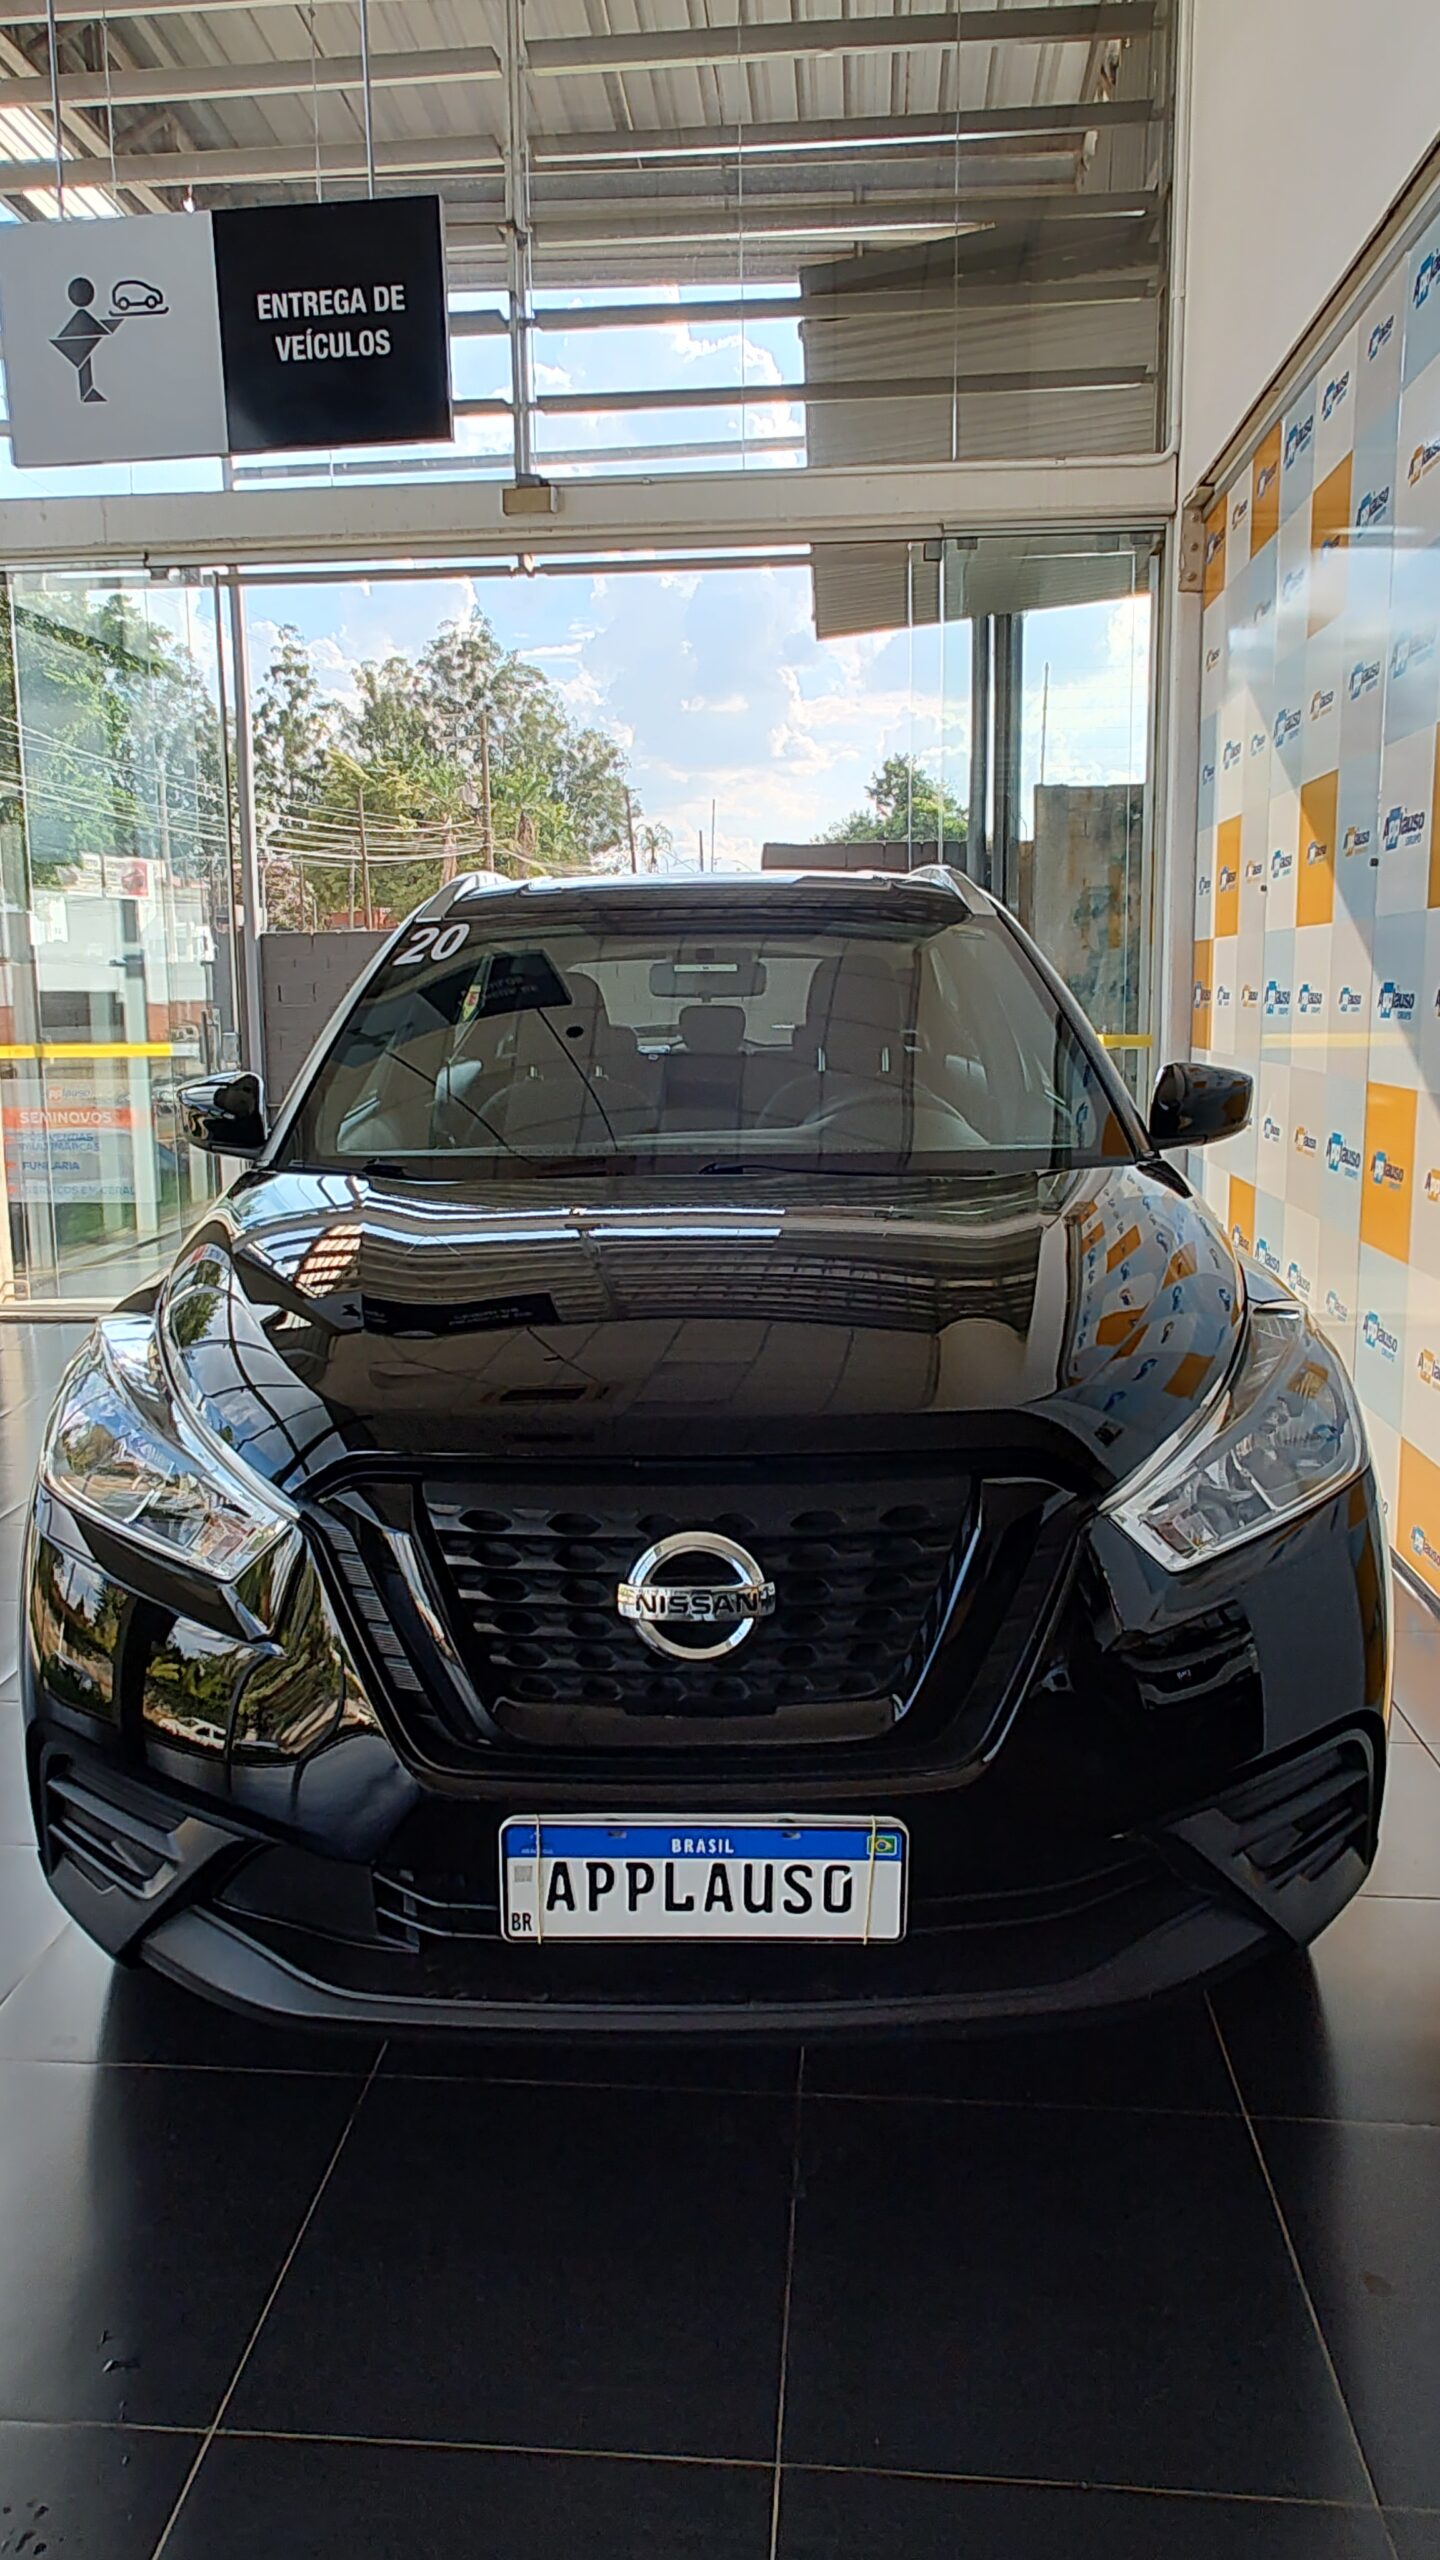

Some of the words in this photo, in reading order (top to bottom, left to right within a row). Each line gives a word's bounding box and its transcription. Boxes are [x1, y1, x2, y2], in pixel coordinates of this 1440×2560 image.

[257, 288, 367, 320] ENTREGA
[374, 285, 405, 312] DE
[275, 328, 391, 361] VEÍCULOS
[392, 923, 470, 966] 20
[20, 1111, 112, 1124] SEMINOVOS
[635, 1592, 758, 1614] NISSAN
[671, 1837, 734, 1854] BRASIL
[546, 1861, 852, 1914] APPLAUSO
[511, 1912, 532, 1931] BR
